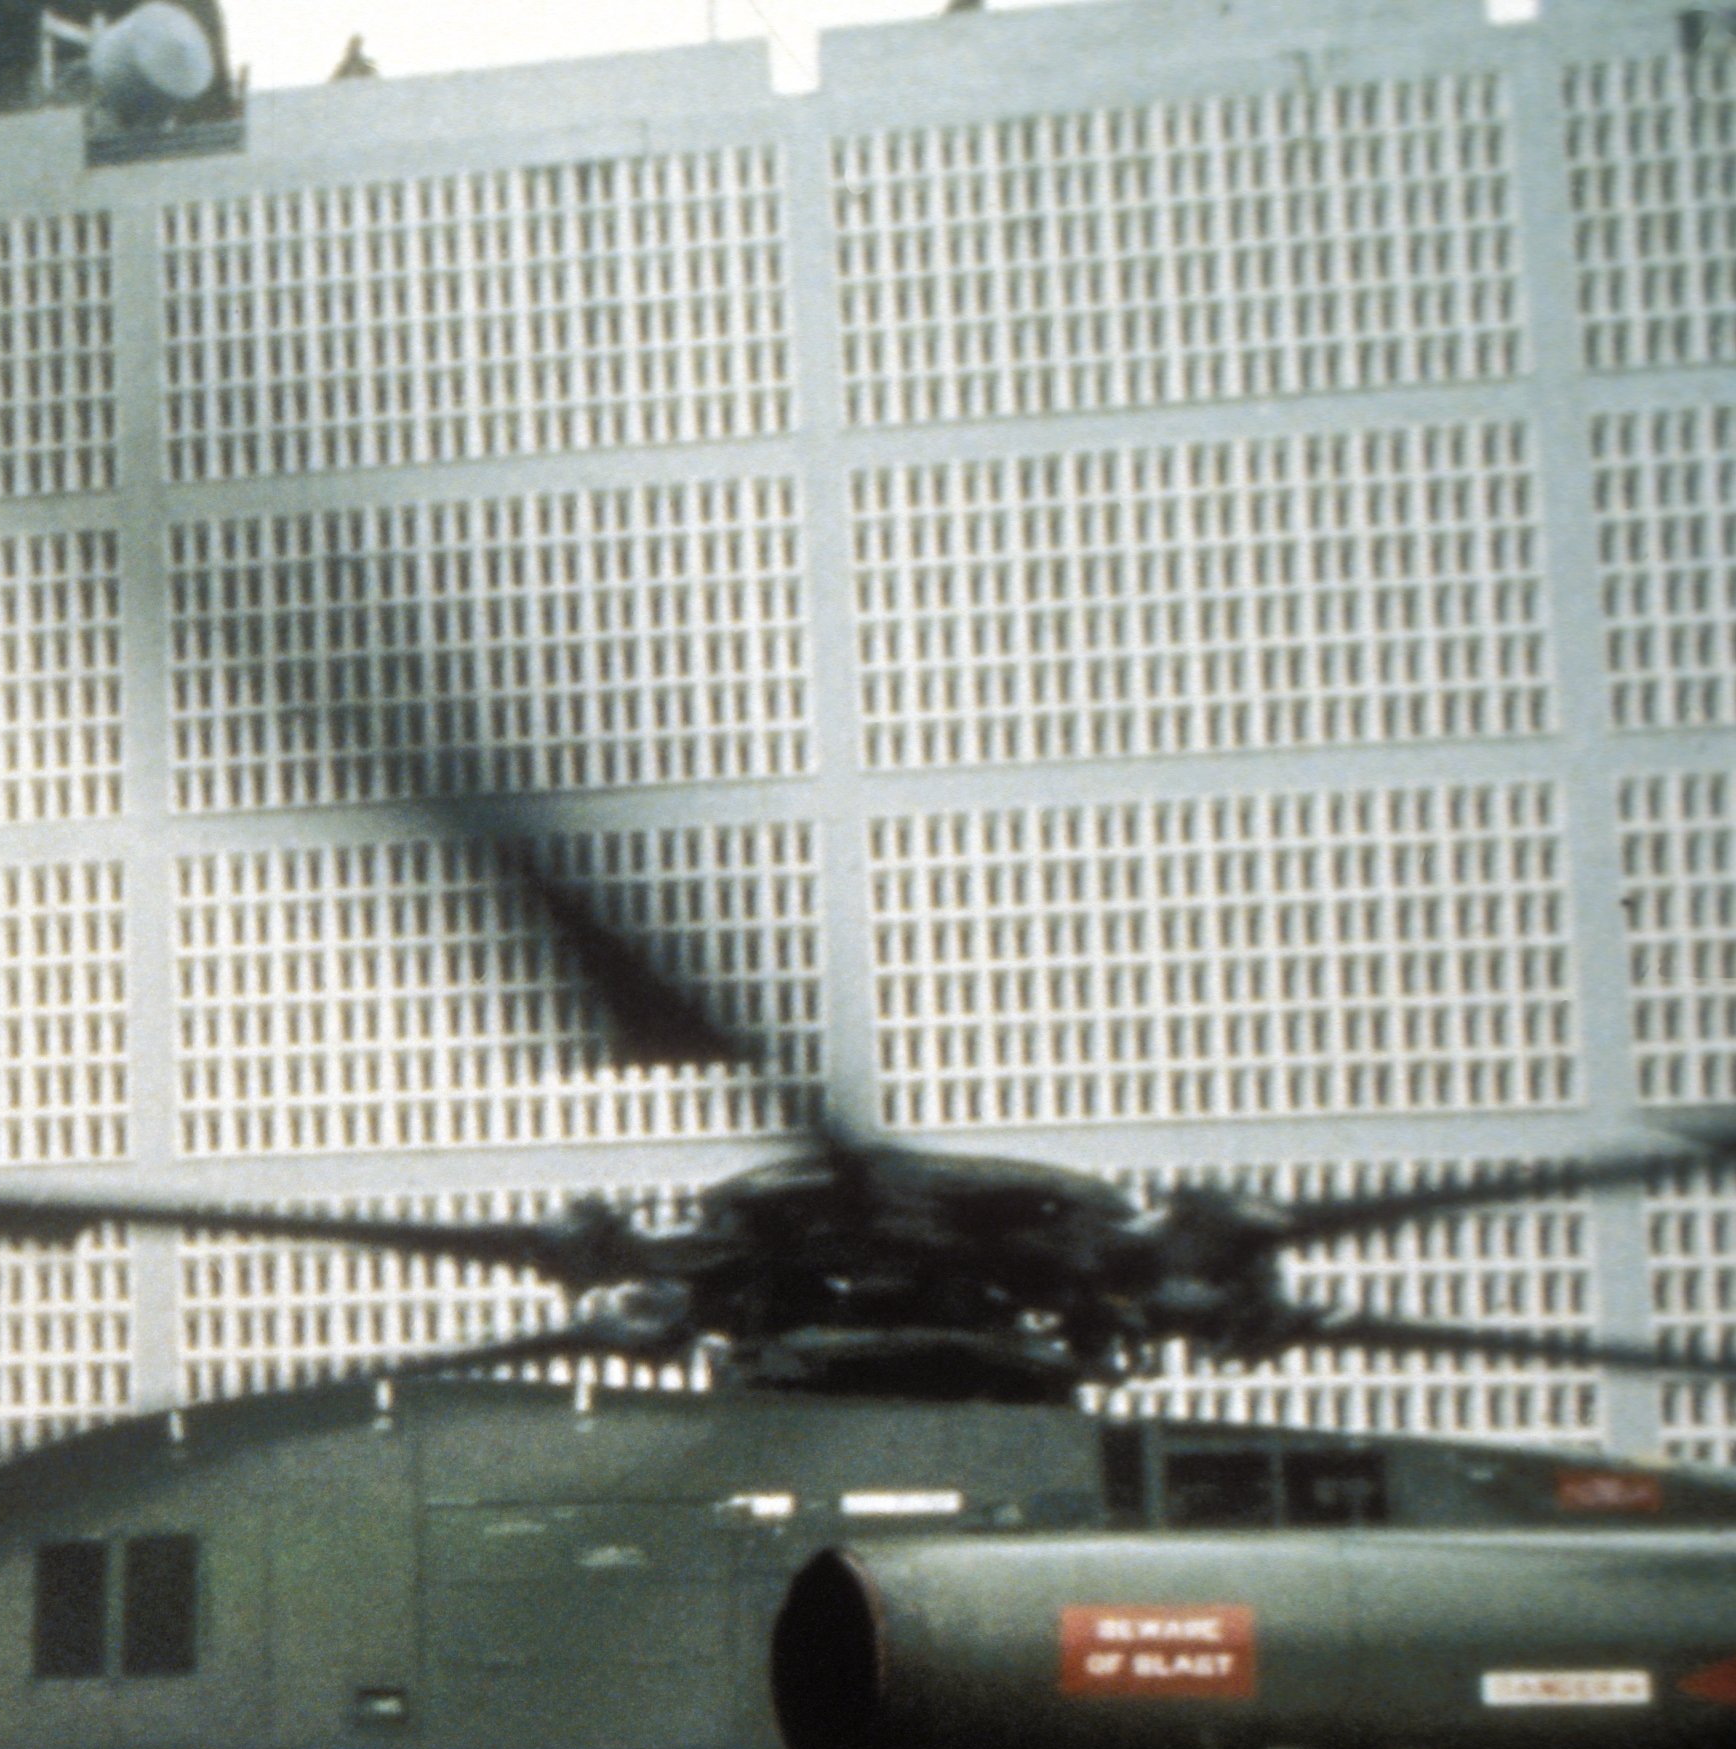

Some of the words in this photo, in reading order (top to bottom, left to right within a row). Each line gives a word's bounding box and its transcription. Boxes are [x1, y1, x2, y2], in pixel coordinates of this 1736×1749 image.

[1095, 1617, 1223, 1643] BEWARE
[1084, 1652, 1125, 1677] OF
[1131, 1652, 1234, 1678] BLAST
